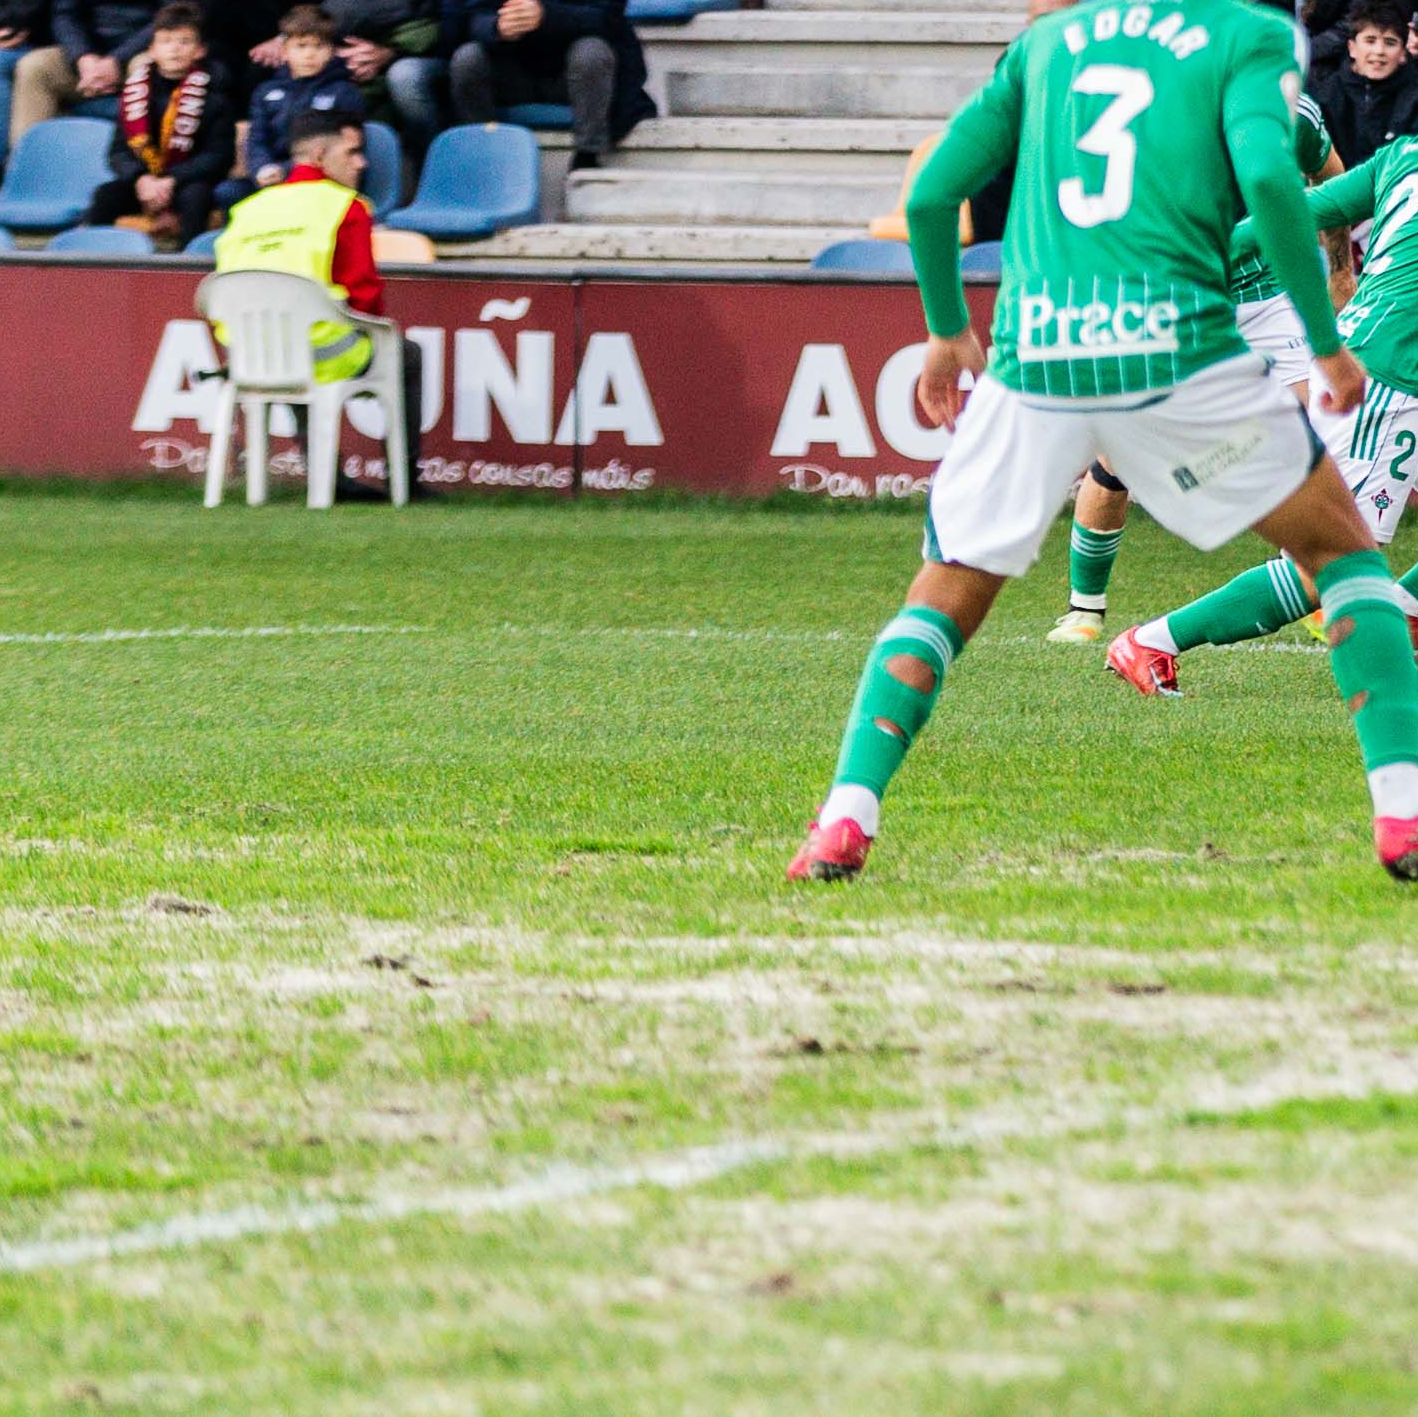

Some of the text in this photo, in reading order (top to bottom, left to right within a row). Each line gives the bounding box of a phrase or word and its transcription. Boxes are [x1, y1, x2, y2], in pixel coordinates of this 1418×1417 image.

[1057, 64, 1155, 229] 3
[1019, 295, 1181, 350] Prace
[1388, 429, 1417, 482] 2
